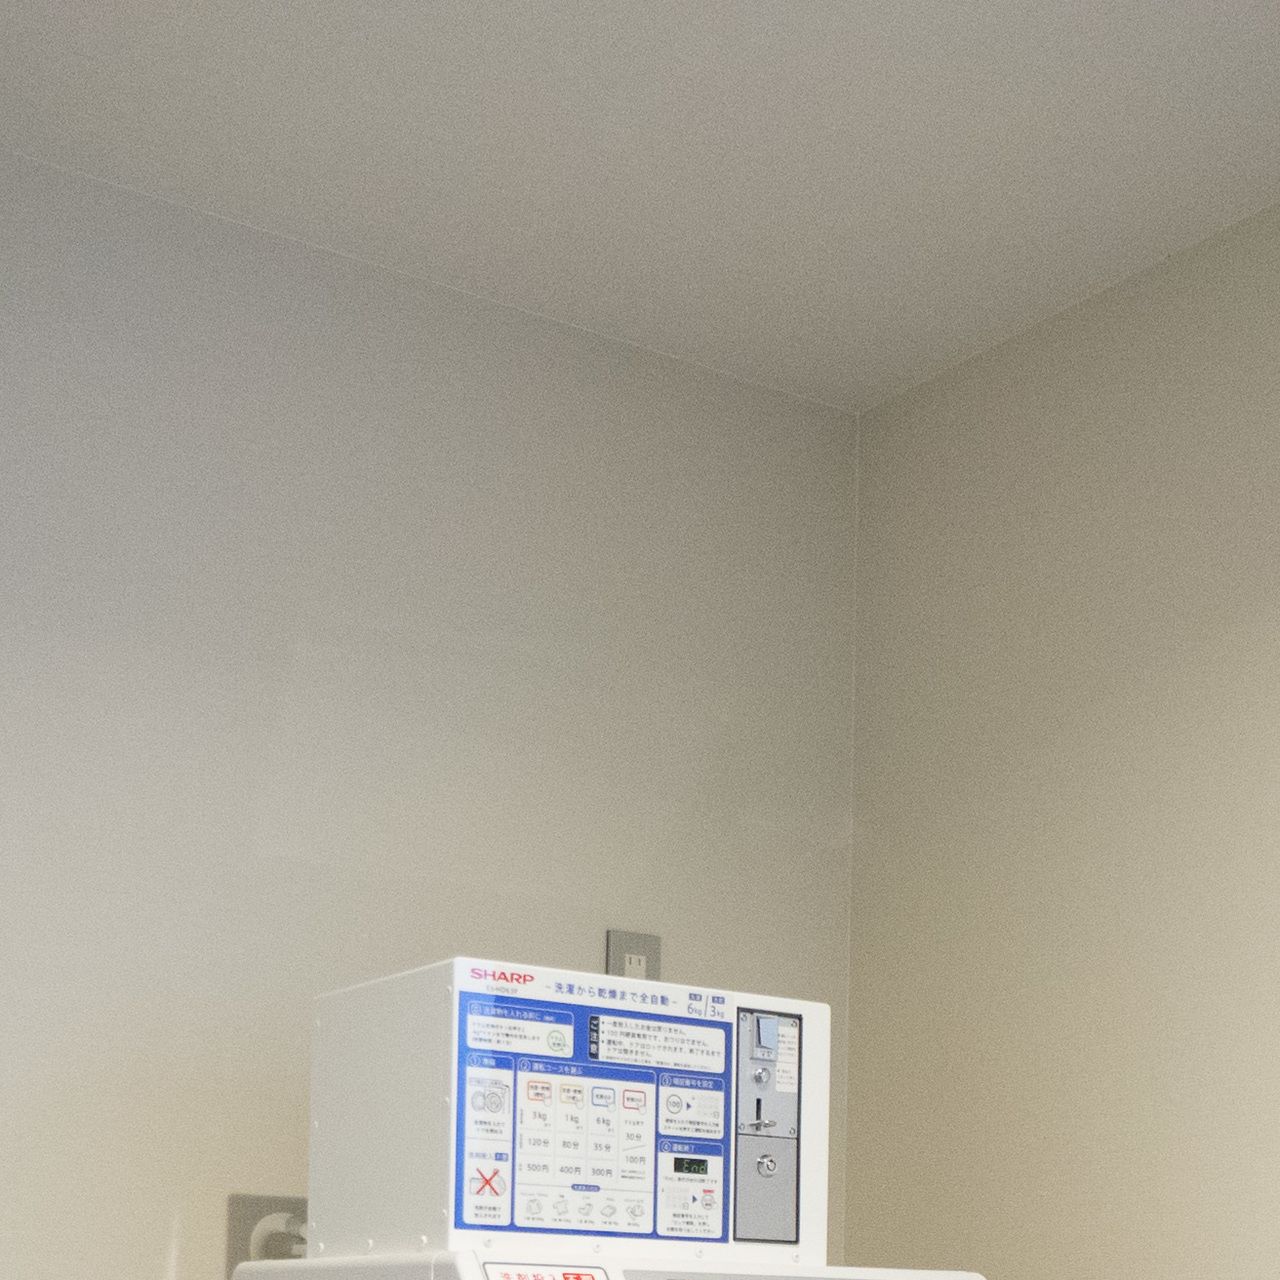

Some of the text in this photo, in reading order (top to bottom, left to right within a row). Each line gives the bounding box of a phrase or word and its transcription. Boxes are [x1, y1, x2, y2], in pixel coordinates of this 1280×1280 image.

[470, 967, 535, 985] SHARP
[554, 982, 670, 1007] 洗濯から乾燥まで全自動
[682, 1160, 706, 1174] End
